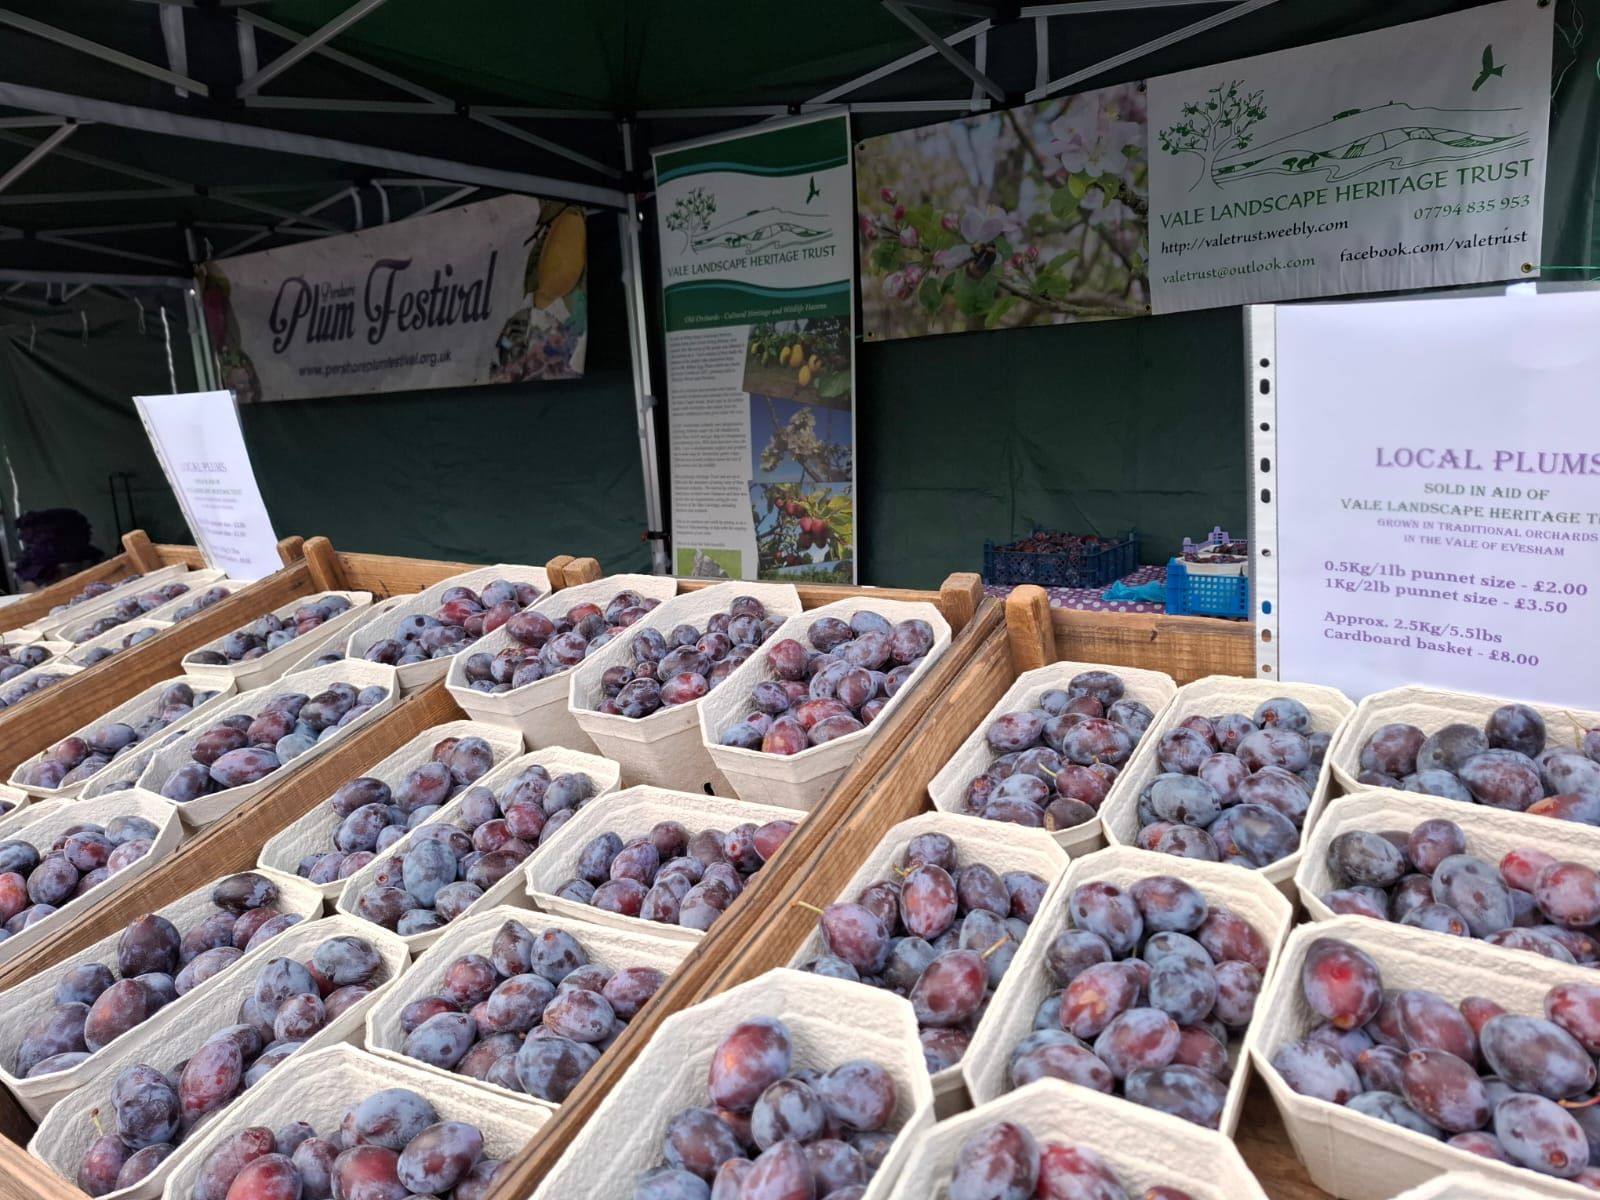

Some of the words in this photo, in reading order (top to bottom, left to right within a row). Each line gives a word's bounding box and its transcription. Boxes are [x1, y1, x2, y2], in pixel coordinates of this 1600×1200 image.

[1160, 208, 1205, 229] VALE
[1211, 188, 1328, 221] LANDSCAPE
[1336, 170, 1448, 203] HERITAGE
[1456, 158, 1535, 185] TRUST
[1414, 203, 1463, 220] 07794
[1466, 199, 1495, 214] 835
[1500, 194, 1530, 210] 953
[1161, 219, 1349, 256] http://valetrust.weebly.com
[1340, 230, 1529, 262] facebook.com/valetrust
[667, 265, 689, 277] VALE
[692, 257, 748, 275] LANDSCAPE
[750, 249, 800, 266] HERITAGE
[802, 245, 836, 260] TRUST
[1162, 255, 1315, 284] valetrust@outlook.com
[268, 276, 356, 354] Plum
[364, 250, 498, 345] Festival
[1376, 447, 1483, 470] LOCAL
[1493, 450, 1600, 475] PLUMS
[1424, 482, 1465, 495] SOLD
[1470, 485, 1486, 497] IN
[1491, 486, 1521, 499] AID
[1527, 488, 1550, 501] OF
[1341, 498, 1382, 511] VALE
[1387, 500, 1484, 517] LANDSCAPE
[1489, 507, 1580, 524] HERITAGE
[1586, 512, 1600, 525] T
[1377, 518, 1419, 529] GROWN
[1422, 521, 1434, 529] IN
[1437, 521, 1521, 538] TRADITIONAL
[1525, 528, 1599, 542] ORCHARDS
[1404, 534, 1415, 543] IN
[1419, 535, 1442, 545] THE
[1445, 536, 1478, 549] VALE
[1481, 541, 1498, 551] OF
[1501, 543, 1564, 556] EVESHAM
[1324, 560, 1406, 577] 0.5Kg/1lb
[1411, 568, 1475, 585] punnet
[1480, 575, 1516, 590] size
[1533, 580, 1588, 596] £2.00
[1325, 578, 1390, 593] 1Kg/2lb
[1396, 585, 1459, 602] punnet
[1463, 592, 1498, 606] size
[1514, 597, 1568, 614] £3.50
[1324, 611, 1389, 628] Approx.
[1394, 618, 1502, 643] 2.5Kg/5.5lbs
[1324, 628, 1411, 648] Cardboard
[1416, 637, 1473, 657] basket
[1488, 649, 1539, 666] £8.00
